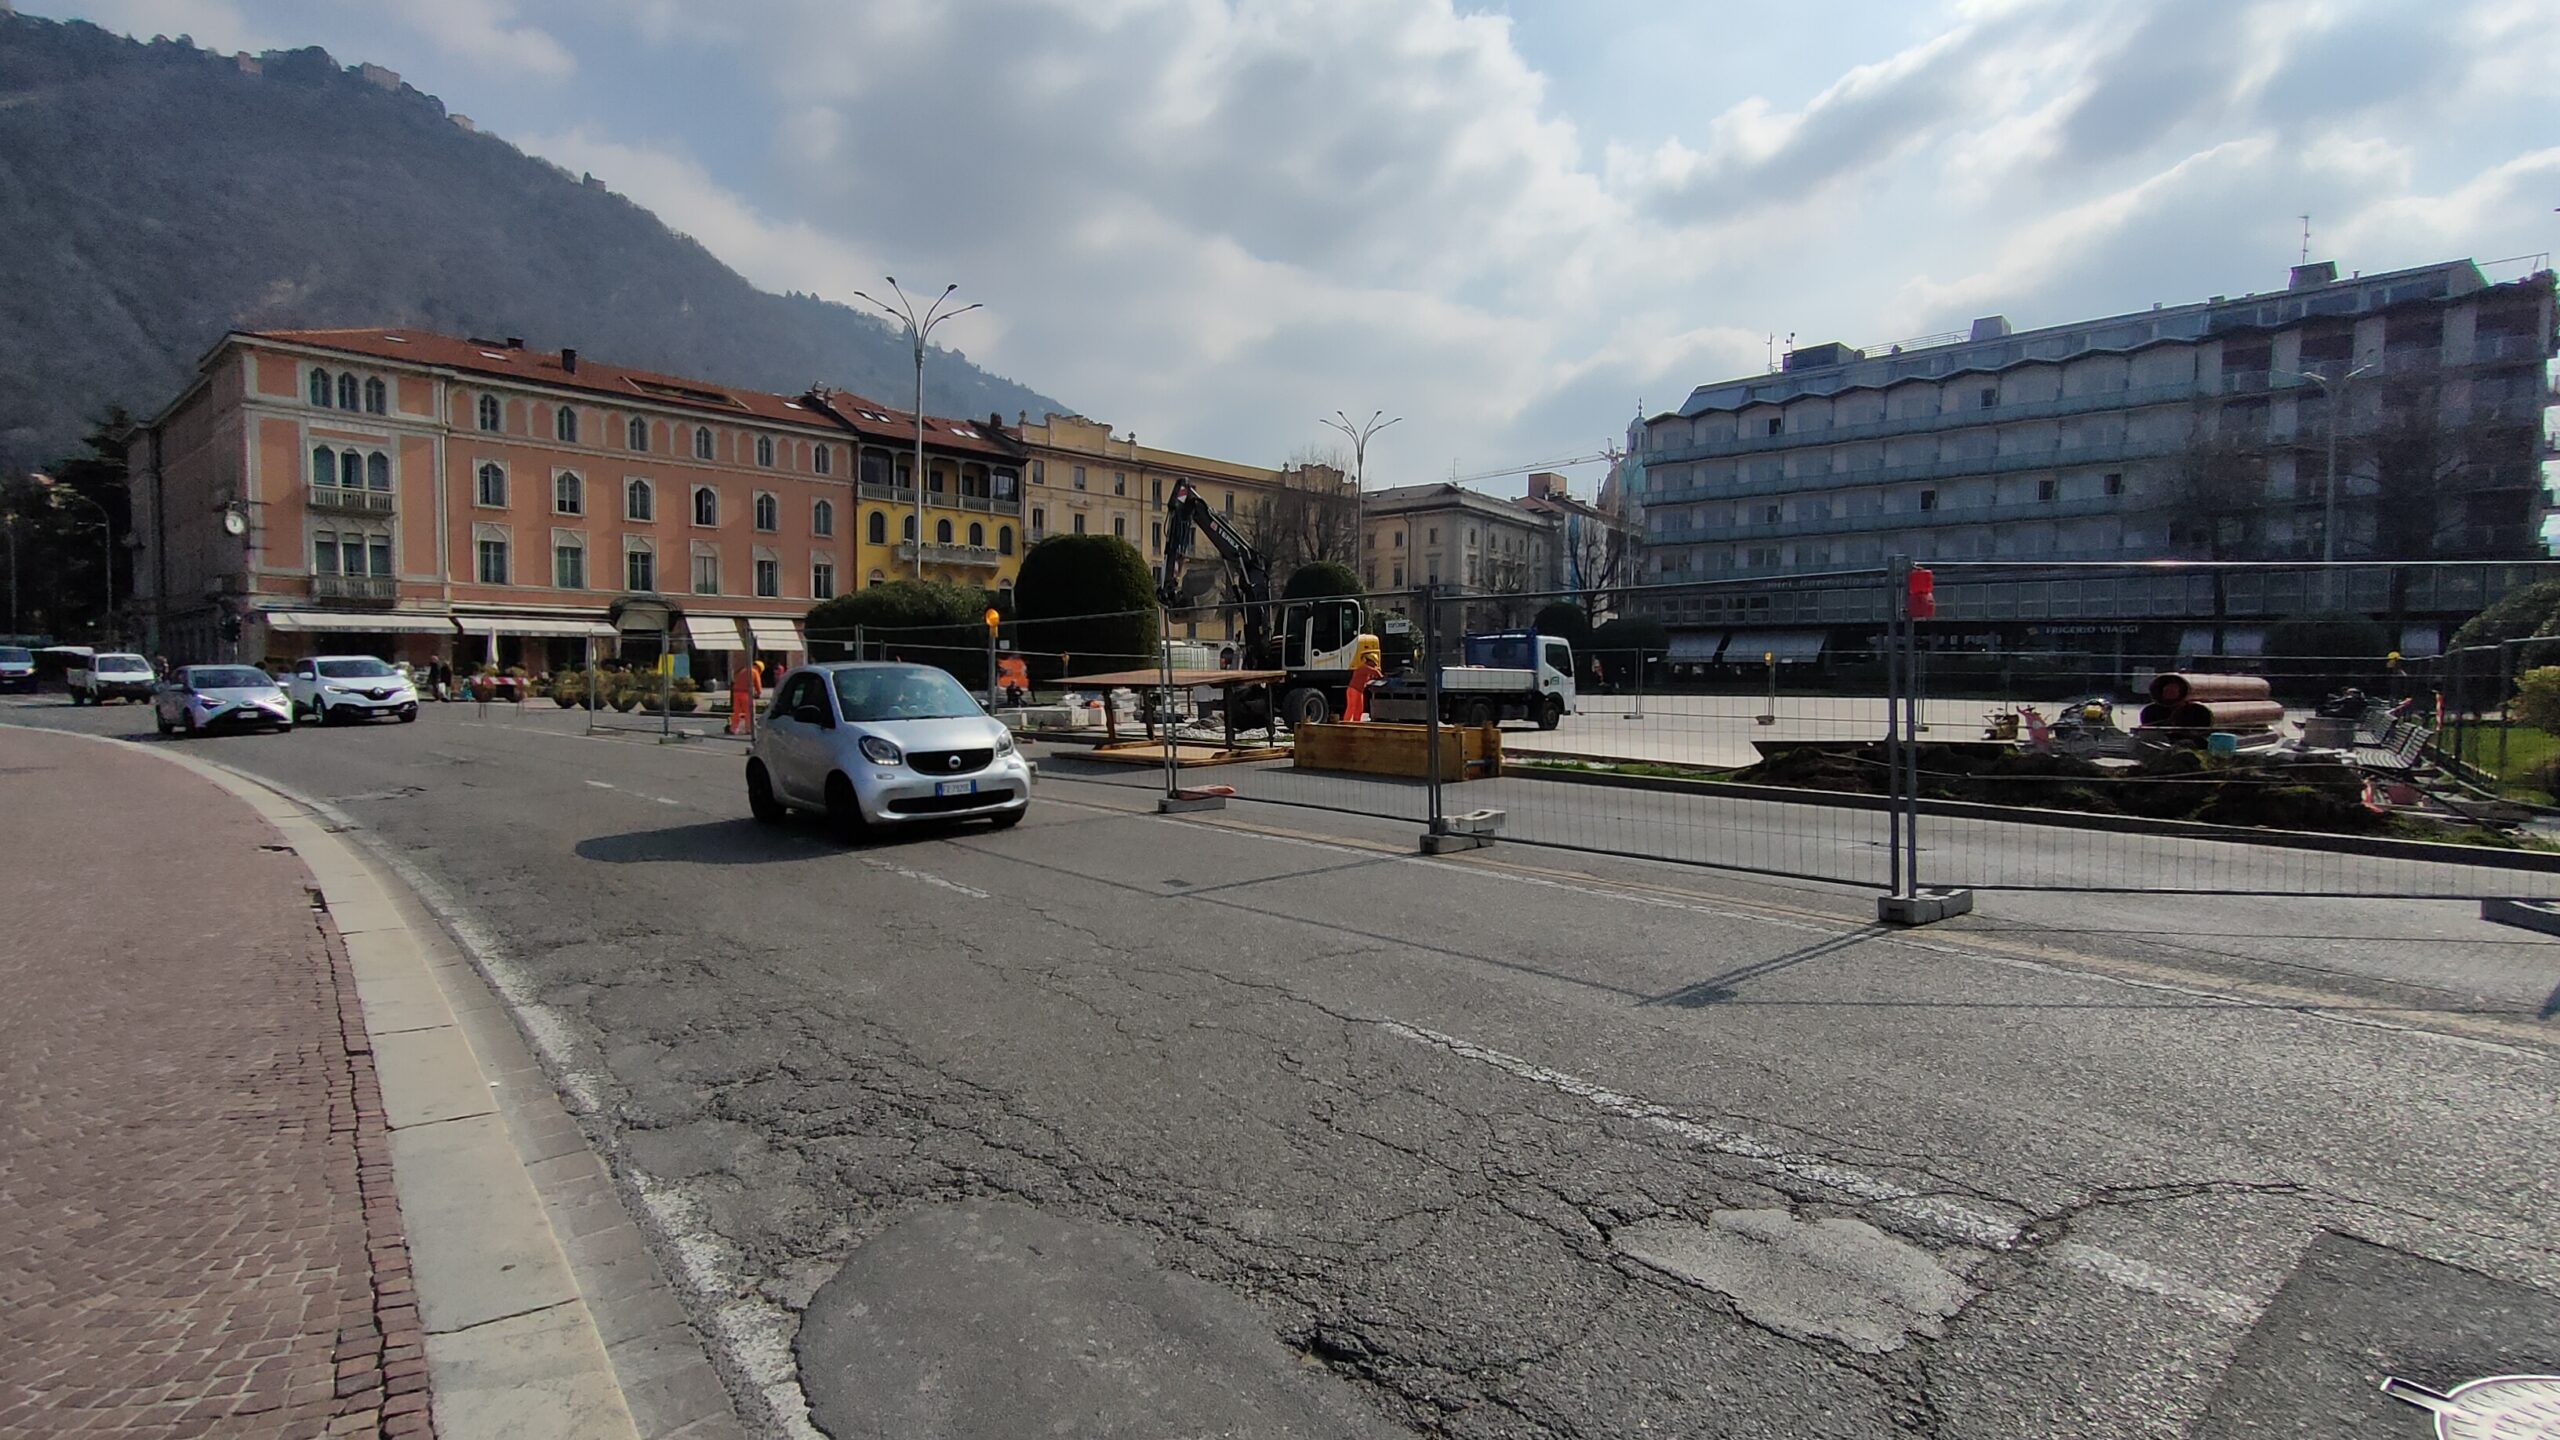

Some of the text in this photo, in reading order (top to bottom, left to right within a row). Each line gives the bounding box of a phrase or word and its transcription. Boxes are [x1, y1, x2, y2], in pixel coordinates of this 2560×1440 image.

[1218, 527, 1240, 551] TEREX
[2045, 625, 2139, 635] FRIGERIO VIAGGI
